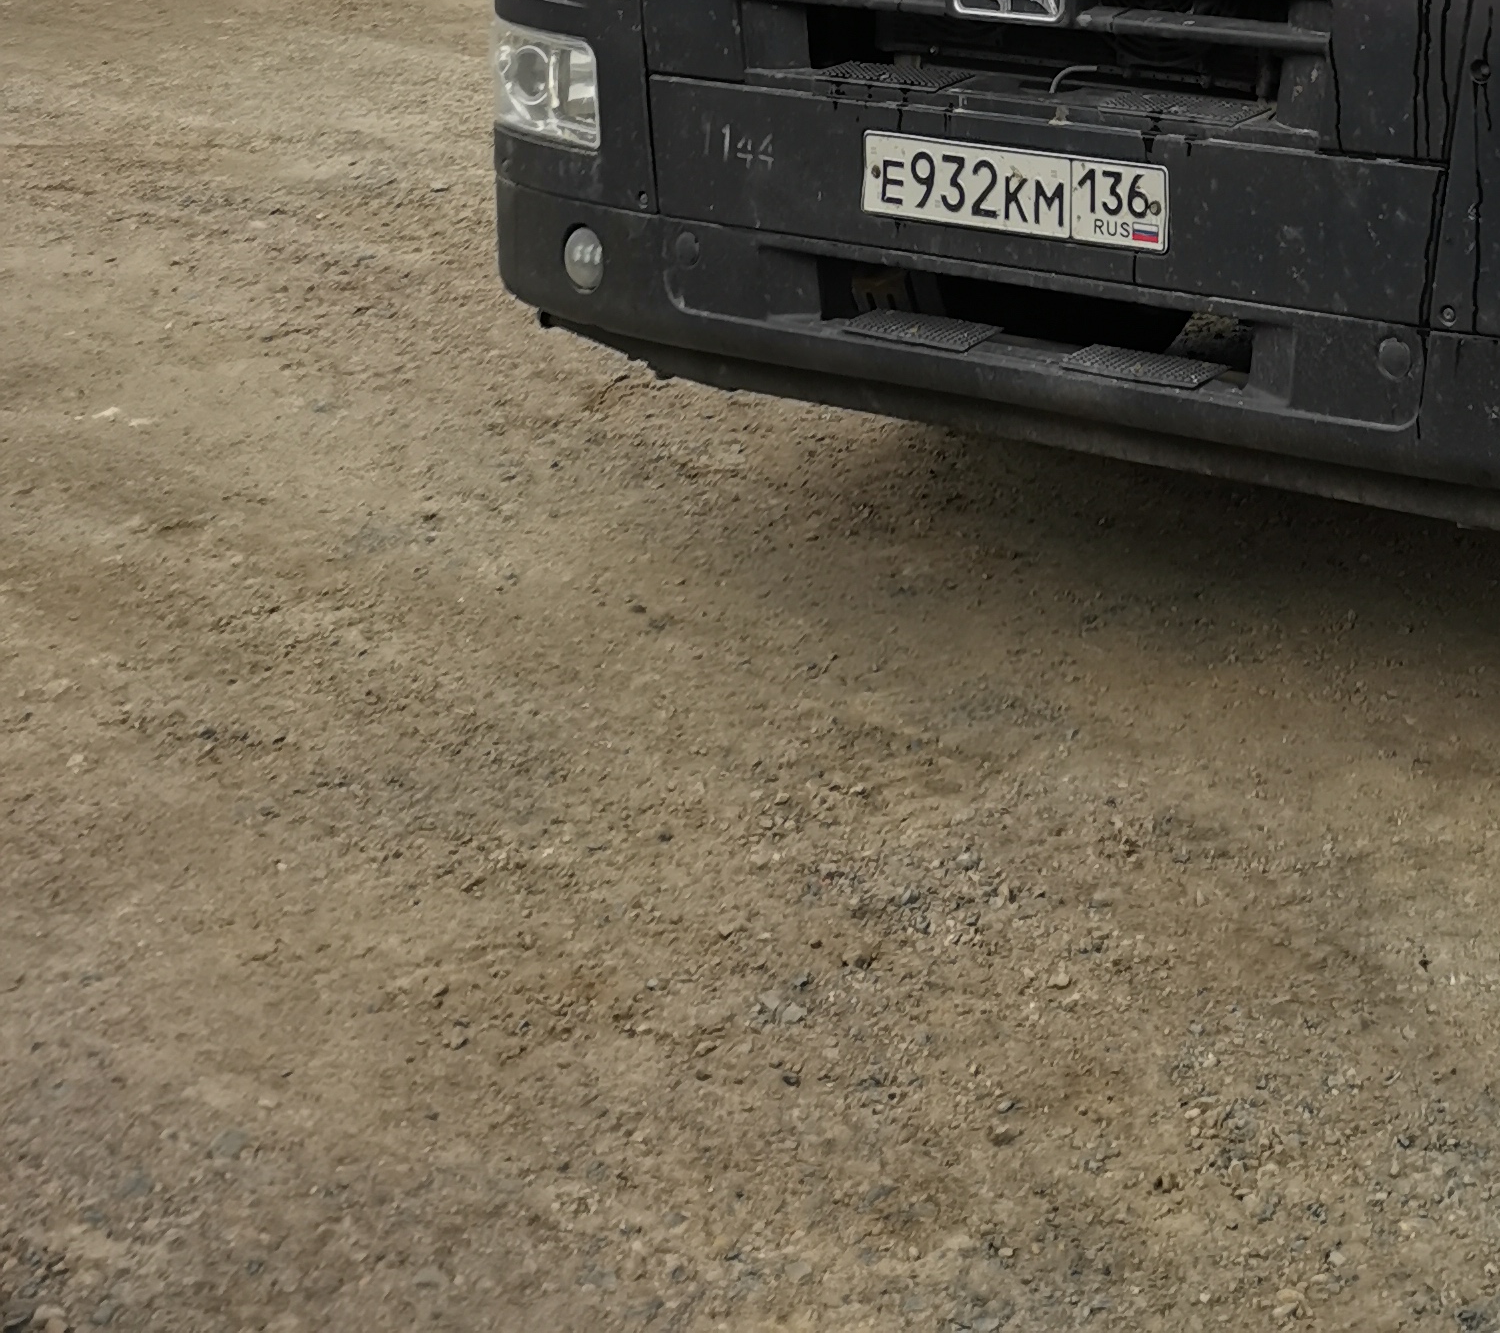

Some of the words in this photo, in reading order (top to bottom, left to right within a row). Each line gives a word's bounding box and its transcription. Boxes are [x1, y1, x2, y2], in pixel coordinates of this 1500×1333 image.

[880, 150, 1065, 228] Е932КМ
[1077, 168, 1149, 219] 136
[1093, 218, 1131, 239] RUS
